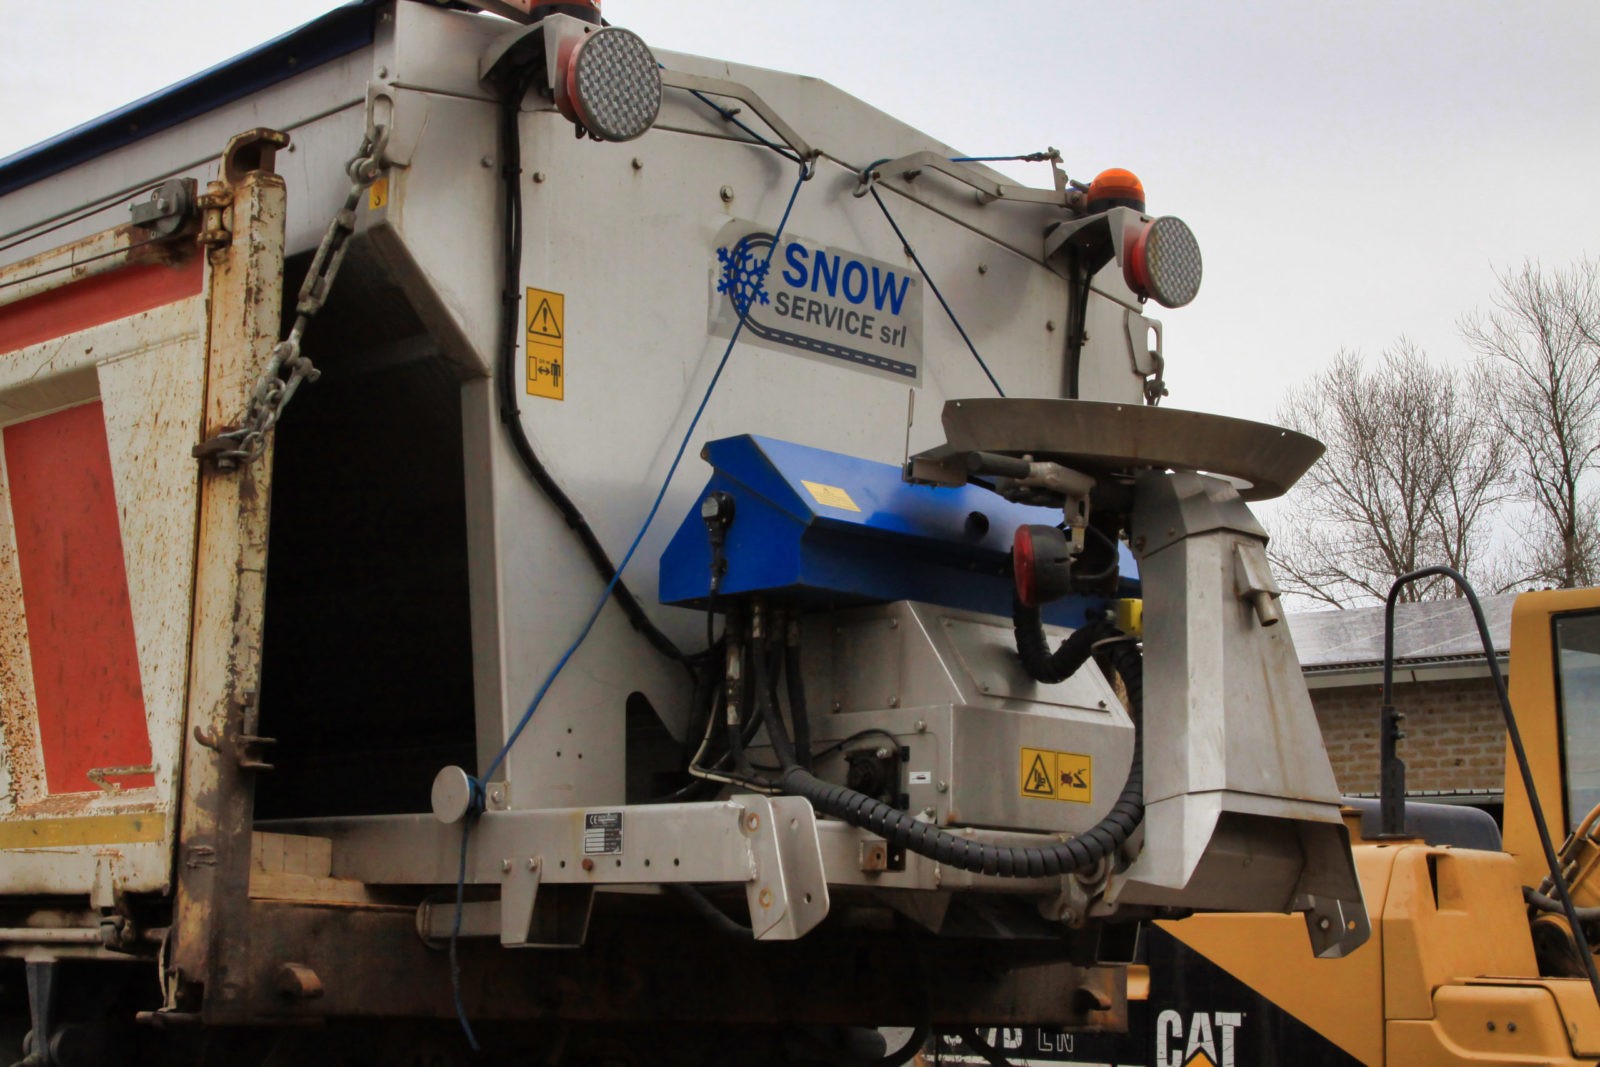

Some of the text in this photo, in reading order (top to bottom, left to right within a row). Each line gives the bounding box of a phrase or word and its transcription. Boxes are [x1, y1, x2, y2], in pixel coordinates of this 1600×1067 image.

[783, 243, 910, 316] SNOW
[774, 292, 907, 348] SERVICE srl
[1156, 1009, 1242, 1067] CAT
